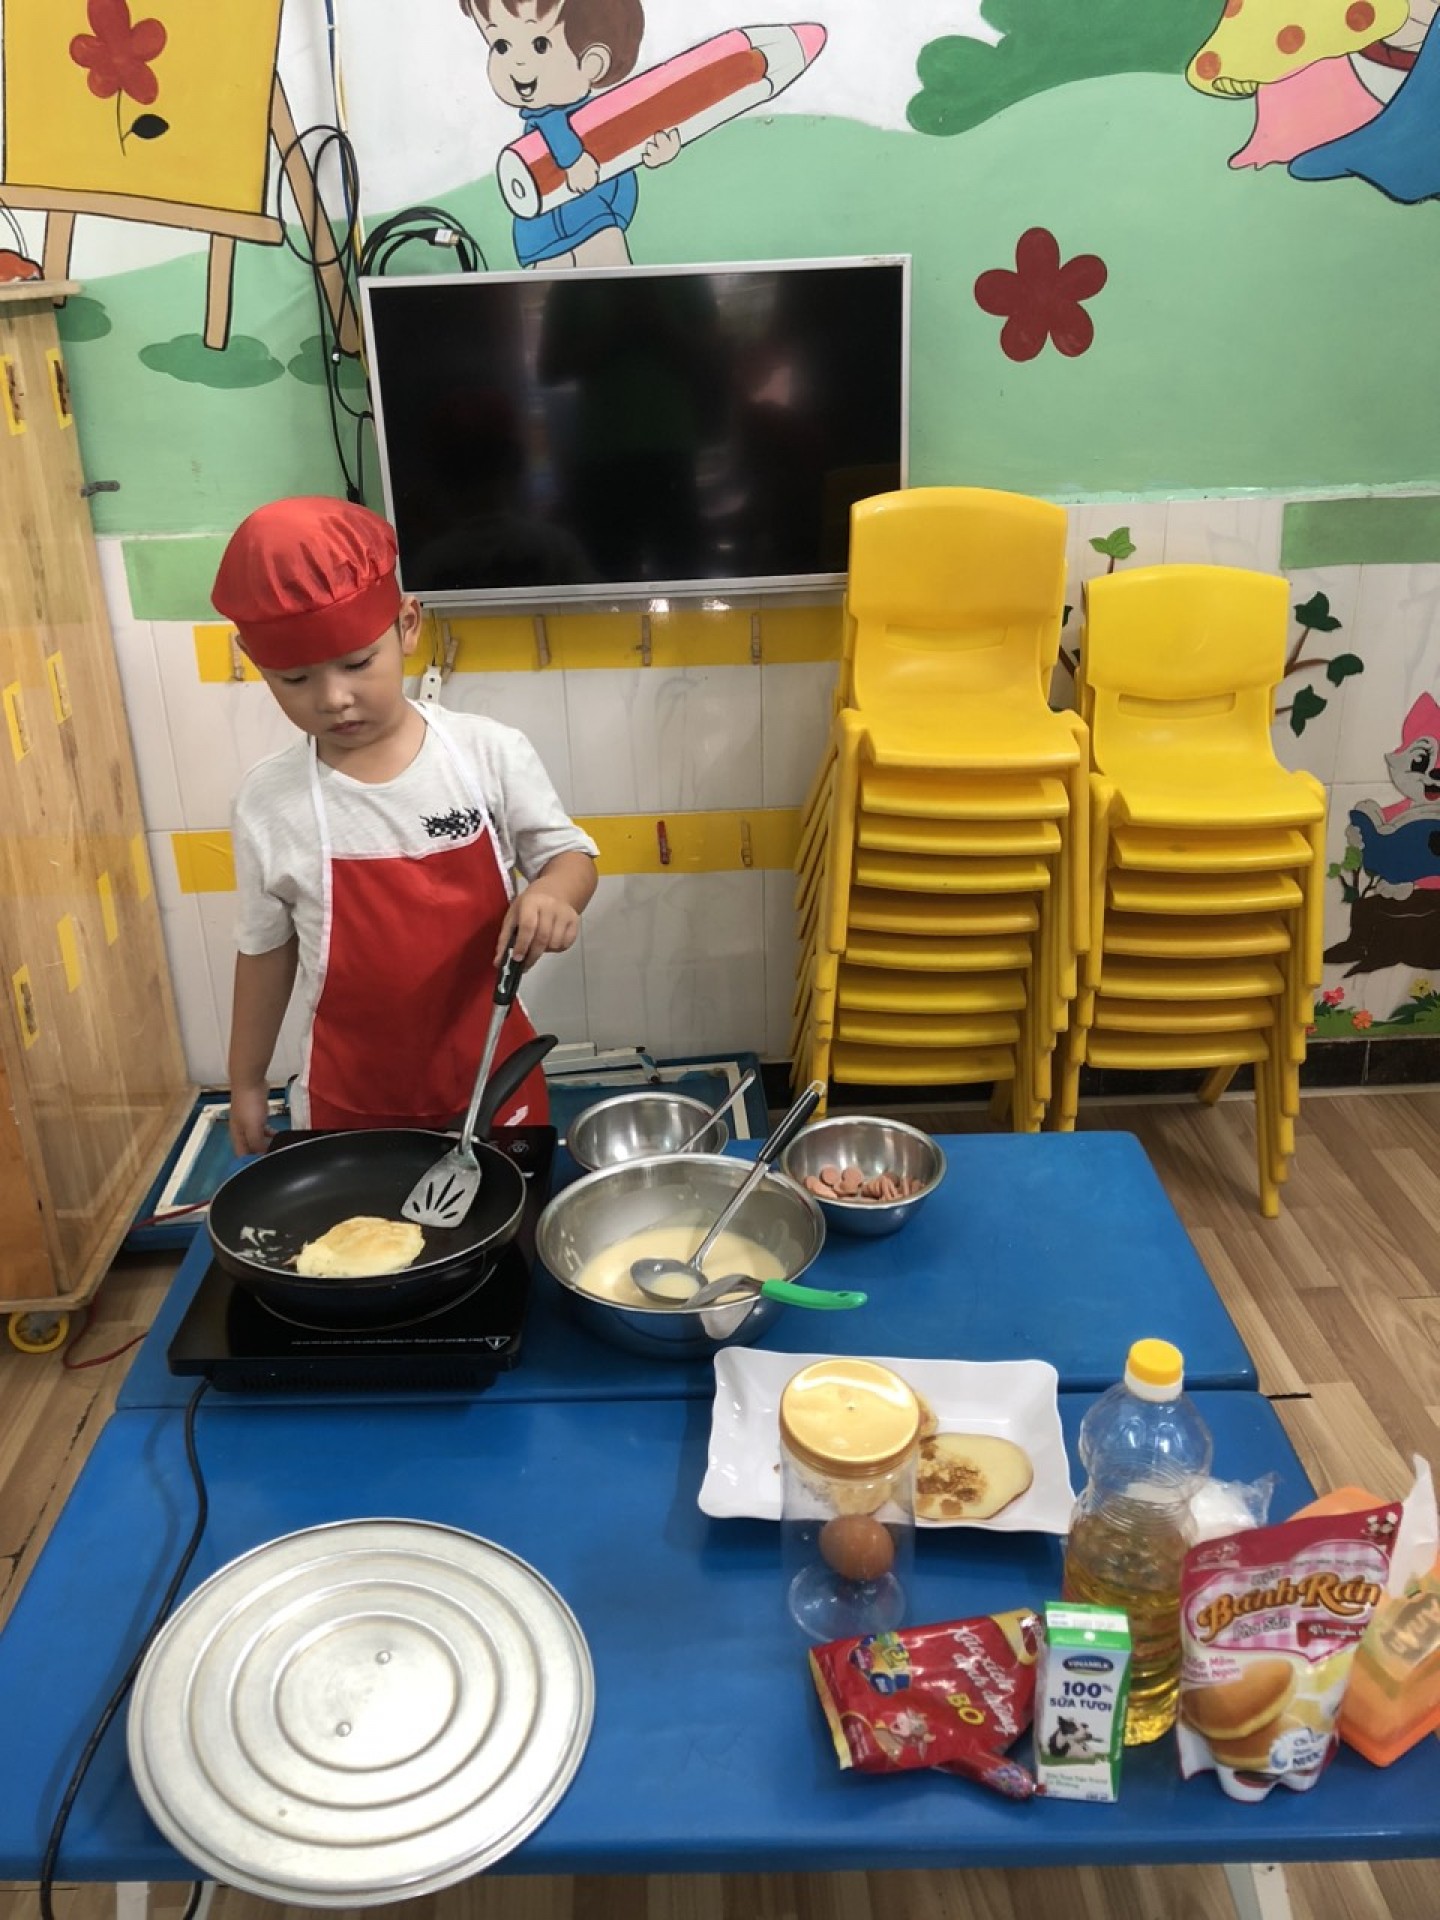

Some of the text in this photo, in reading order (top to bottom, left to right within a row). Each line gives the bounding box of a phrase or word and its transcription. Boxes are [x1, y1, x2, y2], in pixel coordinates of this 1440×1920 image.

[1197, 1571, 1381, 1643] Bánh Rán
[1067, 1660, 1110, 1670] VINAMILK
[1062, 1680, 1114, 1699] 100%
[946, 1691, 986, 1726] BÒ
[1049, 1696, 1113, 1712] SỮA TƯƠI
